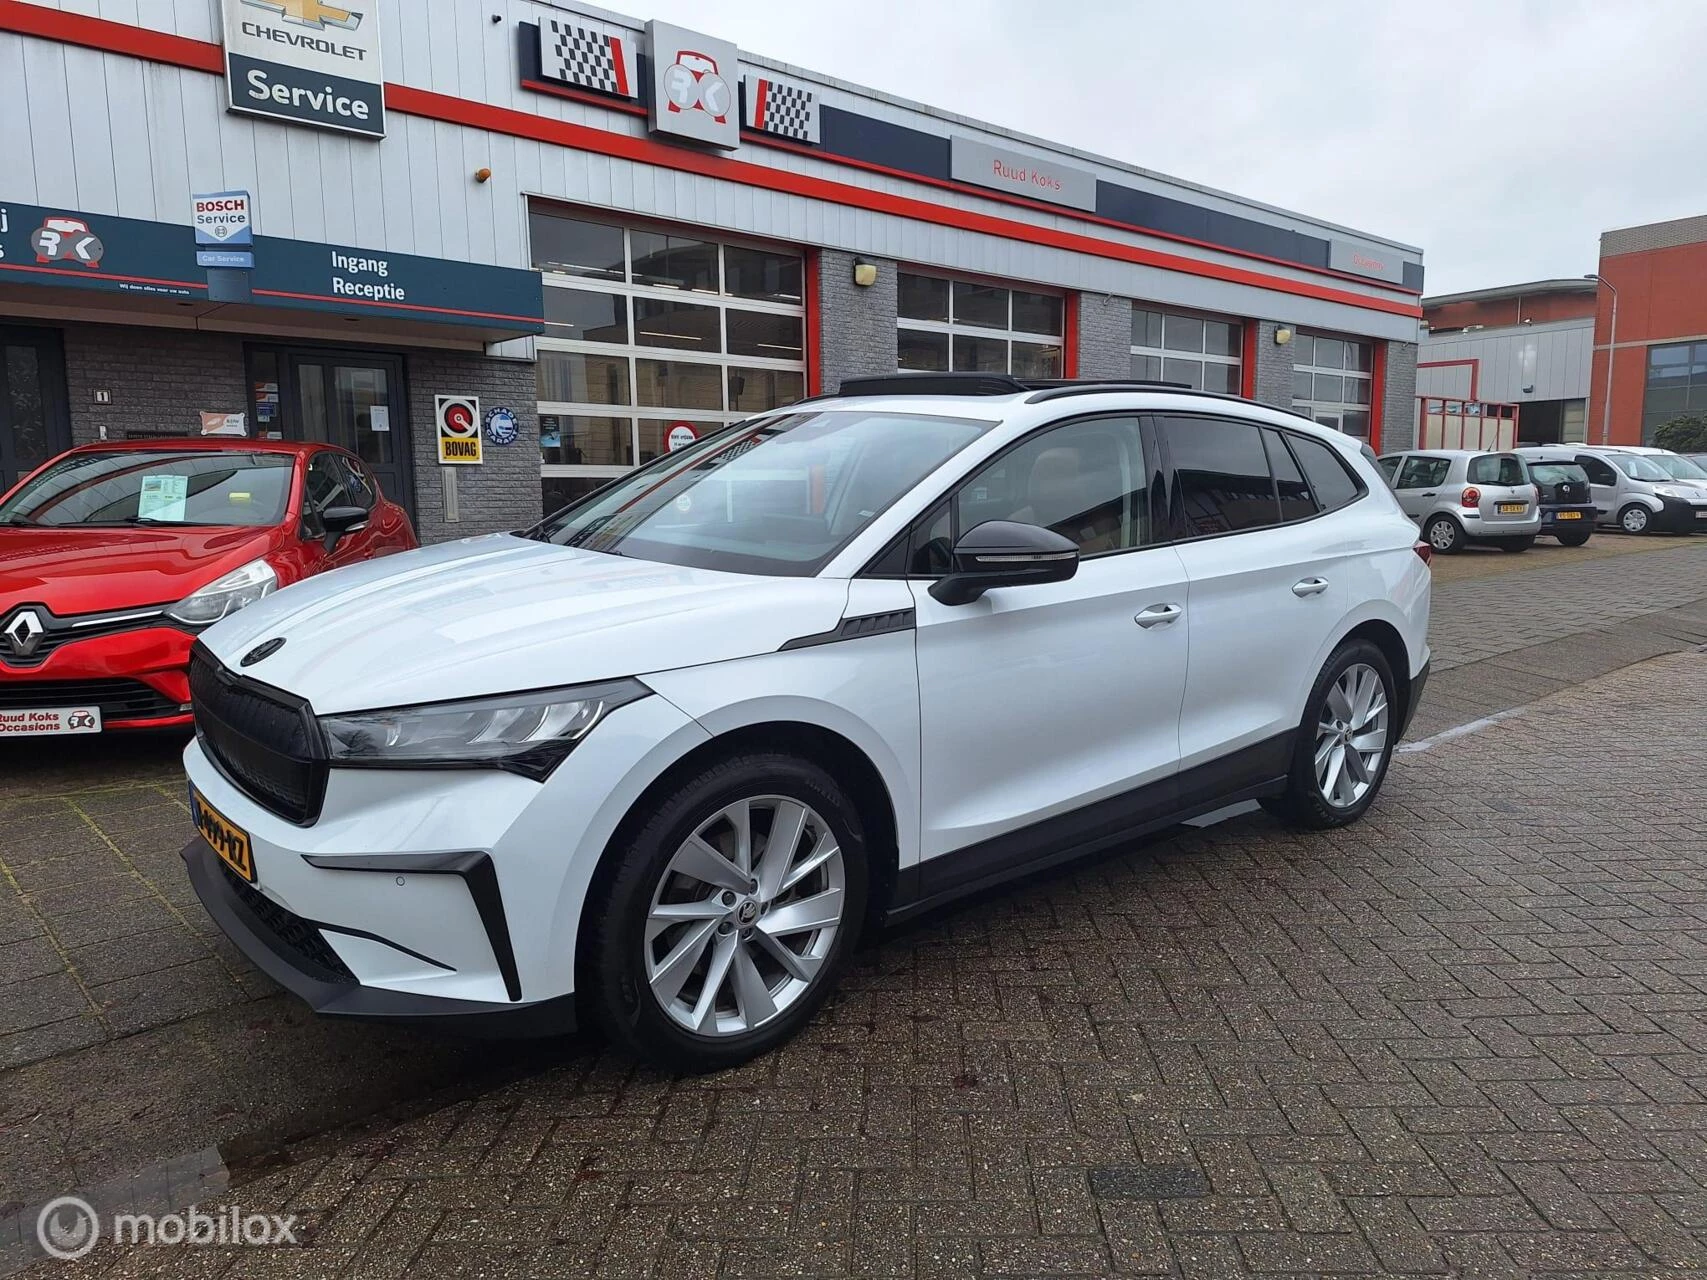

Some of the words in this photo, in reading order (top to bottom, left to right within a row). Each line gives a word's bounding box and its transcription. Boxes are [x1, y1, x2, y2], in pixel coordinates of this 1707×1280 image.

[242, 22, 367, 61] CHEVROLET
[247, 69, 369, 120] Service
[993, 159, 1026, 182] Ruud
[1032, 167, 1061, 191] Koks
[196, 200, 245, 212] BOSCH
[197, 213, 246, 224] Service
[332, 251, 388, 277] Ingang
[332, 277, 405, 301] Receptie
[445, 441, 477, 457] BOVAG
[0, 722, 60, 732] Occasions
[29, 712, 59, 722] Koks
